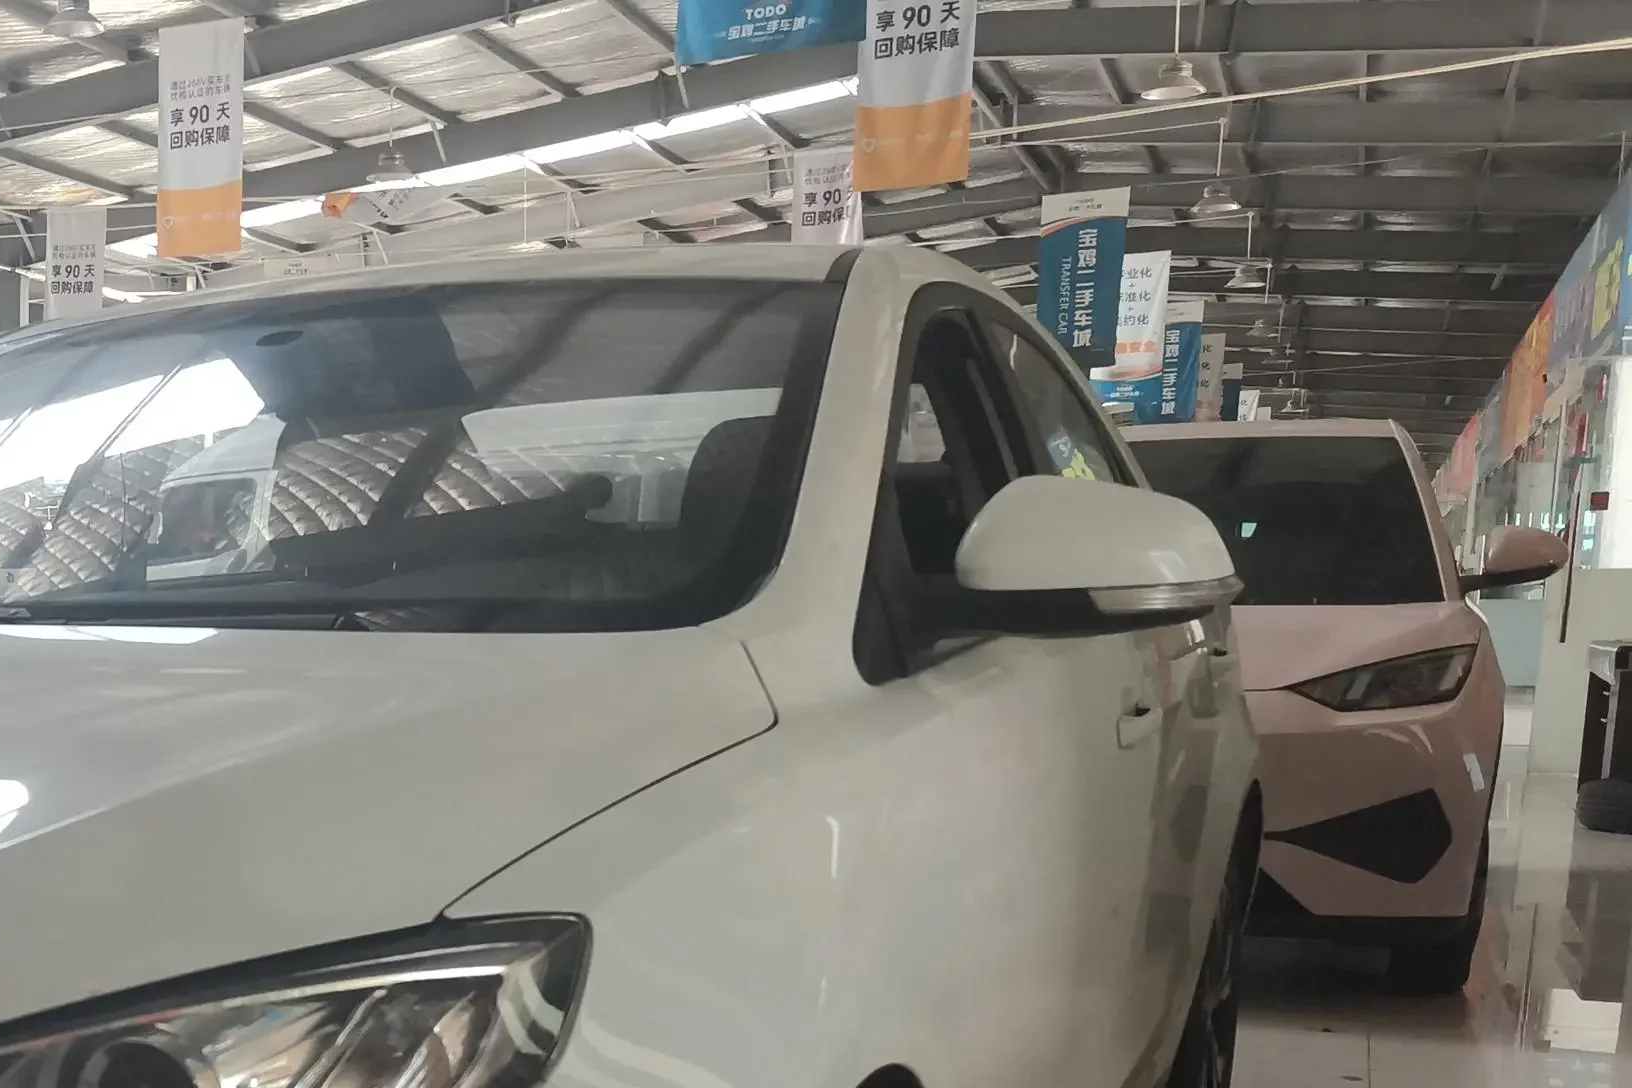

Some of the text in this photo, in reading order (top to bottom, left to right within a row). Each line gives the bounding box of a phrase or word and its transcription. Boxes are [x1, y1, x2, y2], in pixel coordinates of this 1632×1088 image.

[745, 4, 787, 21] TODO
[875, 1, 960, 32] 享90天
[874, 28, 960, 60] 回购保障
[170, 102, 230, 127] 享90天
[170, 125, 231, 149] 回购保障
[52, 264, 95, 278] 享90天
[51, 281, 94, 294] 回购保障
[1057, 256, 1072, 335] TRANSFER CAR
[1072, 229, 1098, 347] 宝鸡二手车城
[1161, 330, 1180, 415] 宝鸡二手车城
